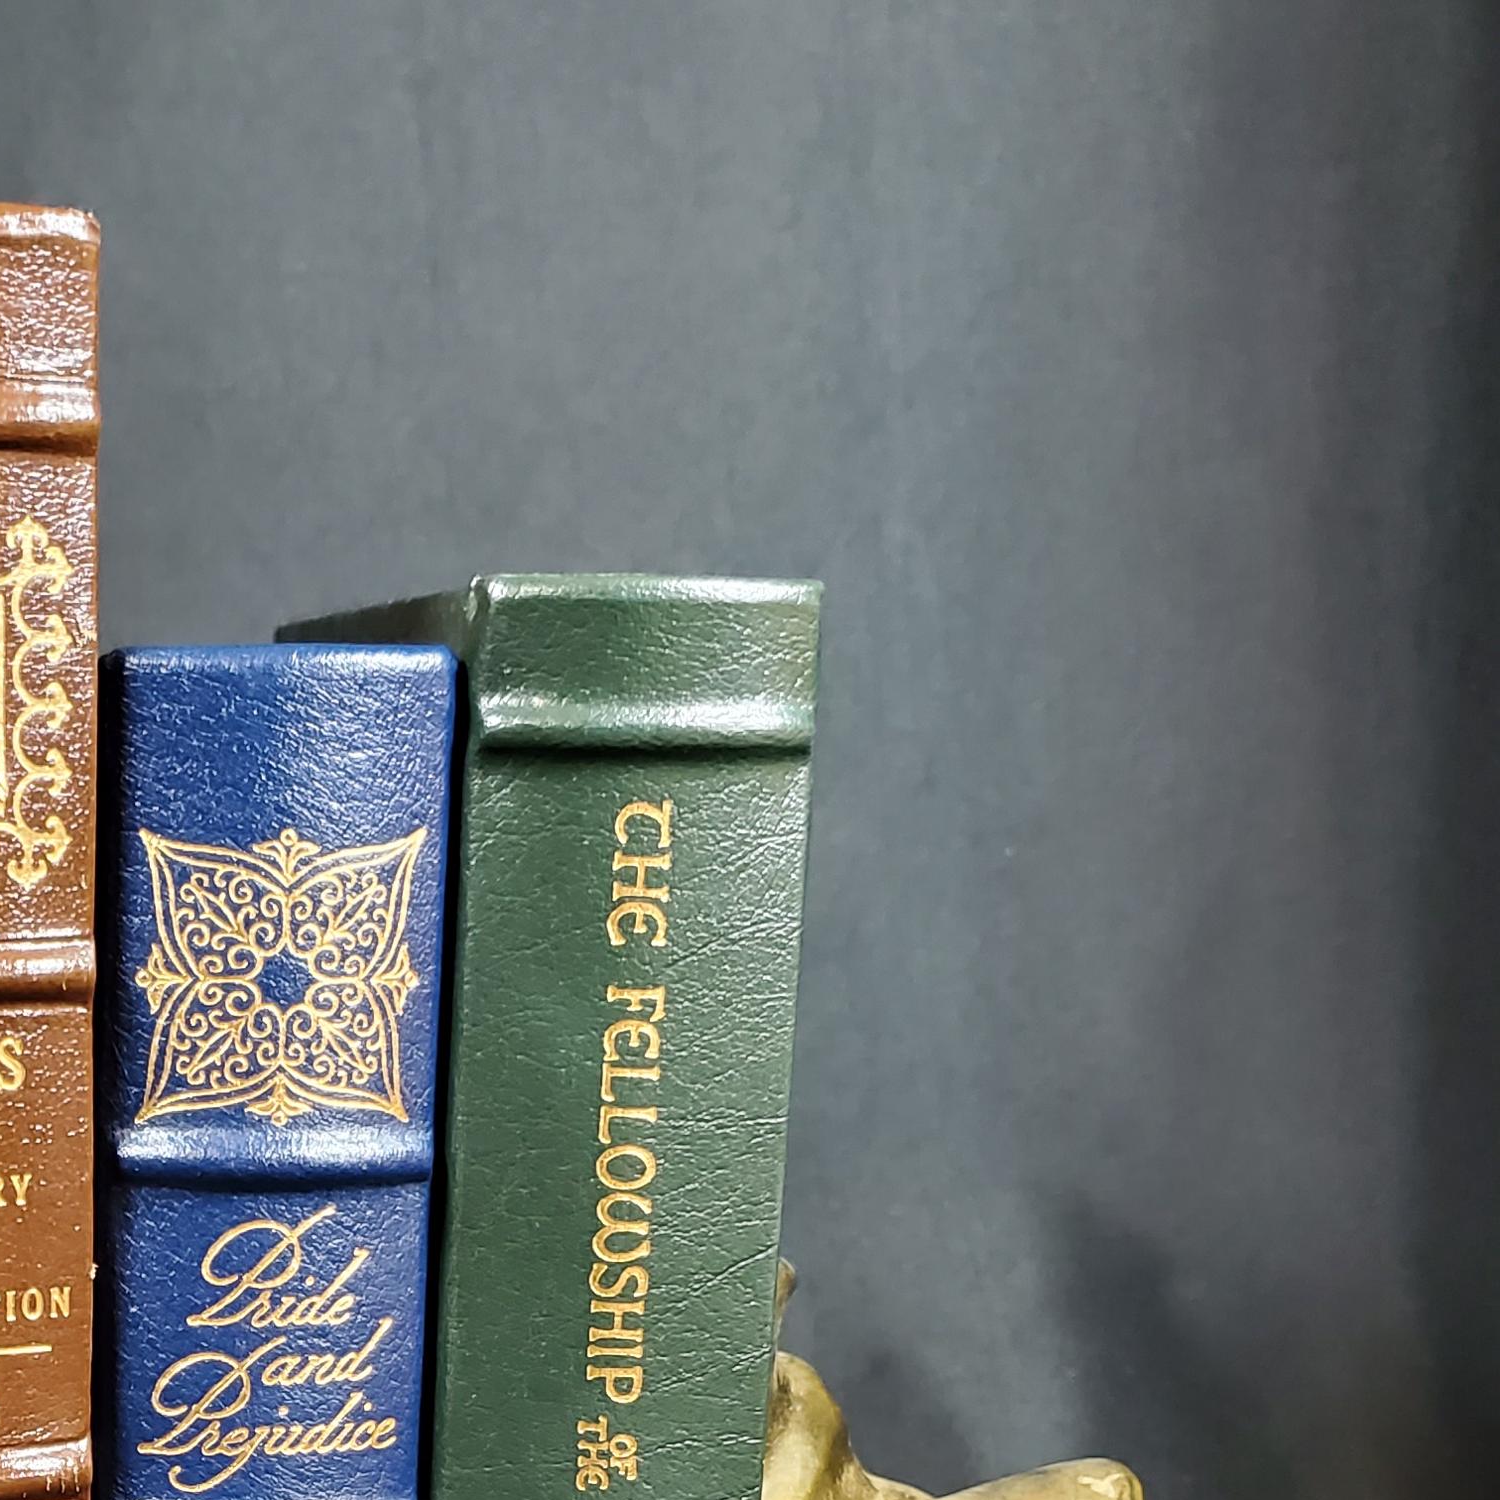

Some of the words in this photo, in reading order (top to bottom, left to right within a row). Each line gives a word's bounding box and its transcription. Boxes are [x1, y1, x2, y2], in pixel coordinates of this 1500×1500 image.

[606, 799, 674, 946] THE
[585, 984, 666, 1404] FELLOWSHIP
[186, 1204, 370, 1327] Pride
[261, 1317, 394, 1386] and
[137, 1336, 398, 1492] Prejudice
[575, 1416, 609, 1491] THE
[609, 1433, 638, 1480] OF
